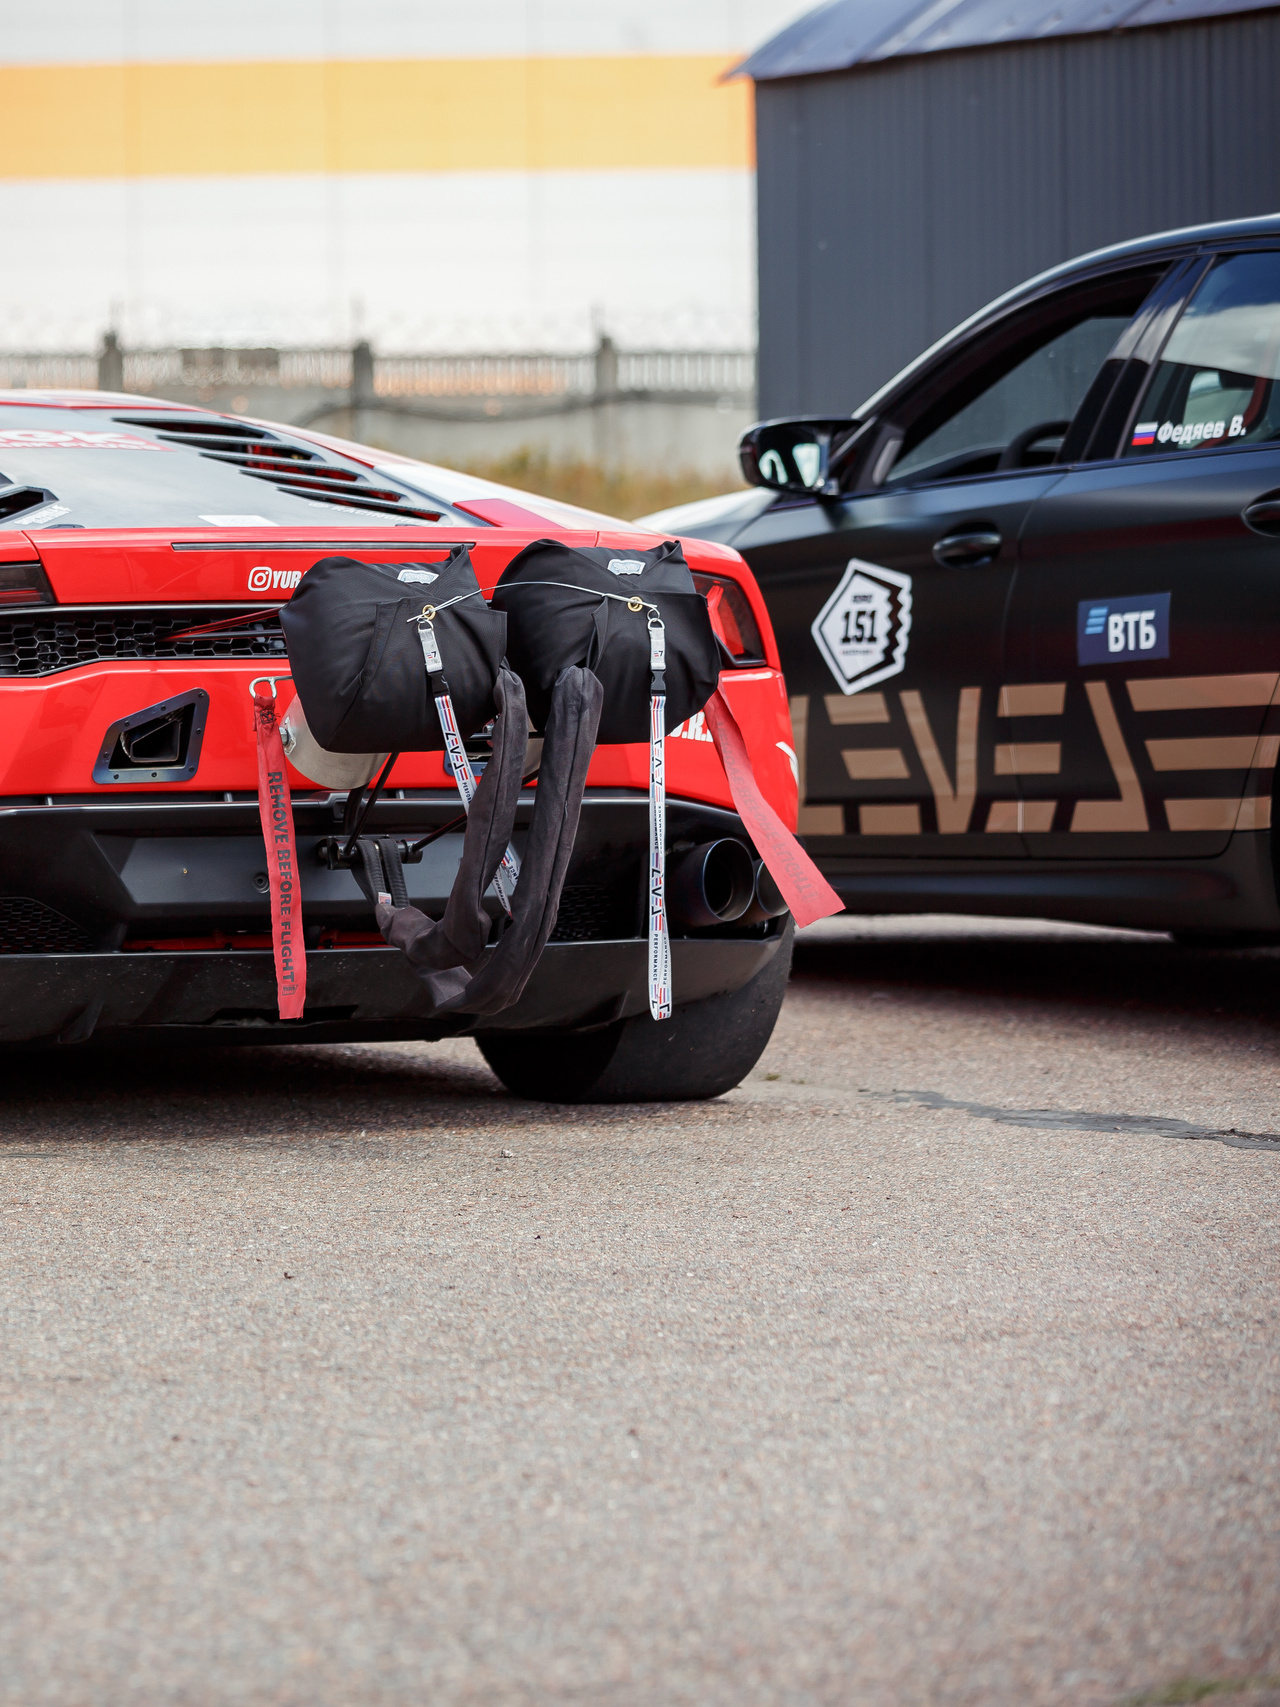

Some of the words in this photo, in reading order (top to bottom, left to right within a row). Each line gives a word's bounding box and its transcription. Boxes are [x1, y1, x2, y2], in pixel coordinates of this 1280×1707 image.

[1157, 421, 1225, 445] Федяев
[1229, 414, 1247, 438] В.
[272, 570, 307, 589] YUR
[841, 610, 877, 643] 151
[1108, 609, 1157, 653] ВТБ
[268, 771, 289, 844] REMOVE
[277, 849, 292, 916] BEFORE
[281, 921, 295, 983] FLIGHT
